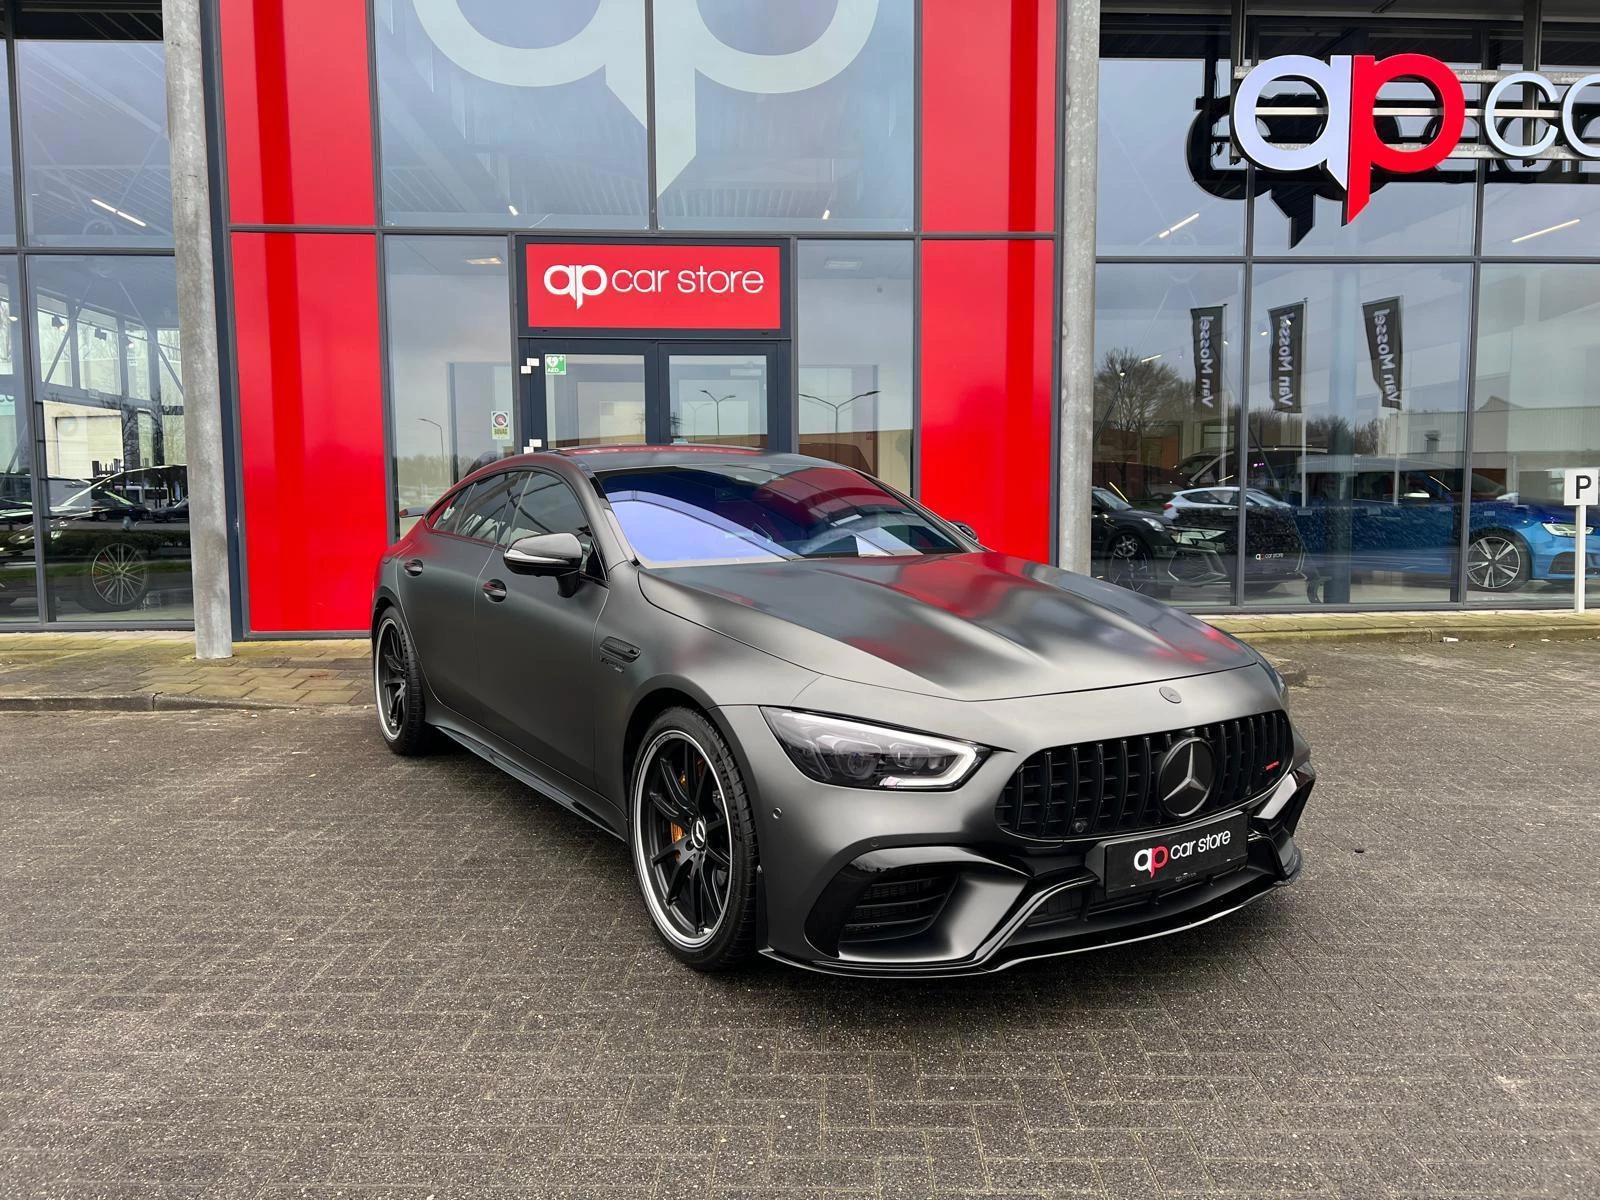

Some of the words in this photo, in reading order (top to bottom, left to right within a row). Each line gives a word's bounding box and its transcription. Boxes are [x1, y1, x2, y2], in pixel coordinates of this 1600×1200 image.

[1234, 53, 1466, 224] ap
[543, 264, 608, 310] ap
[612, 269, 671, 293] car
[677, 265, 765, 294] store
[1575, 475, 1592, 500] P
[1133, 846, 1169, 879] ap
[1170, 840, 1196, 860] car
[1197, 830, 1231, 853] store
